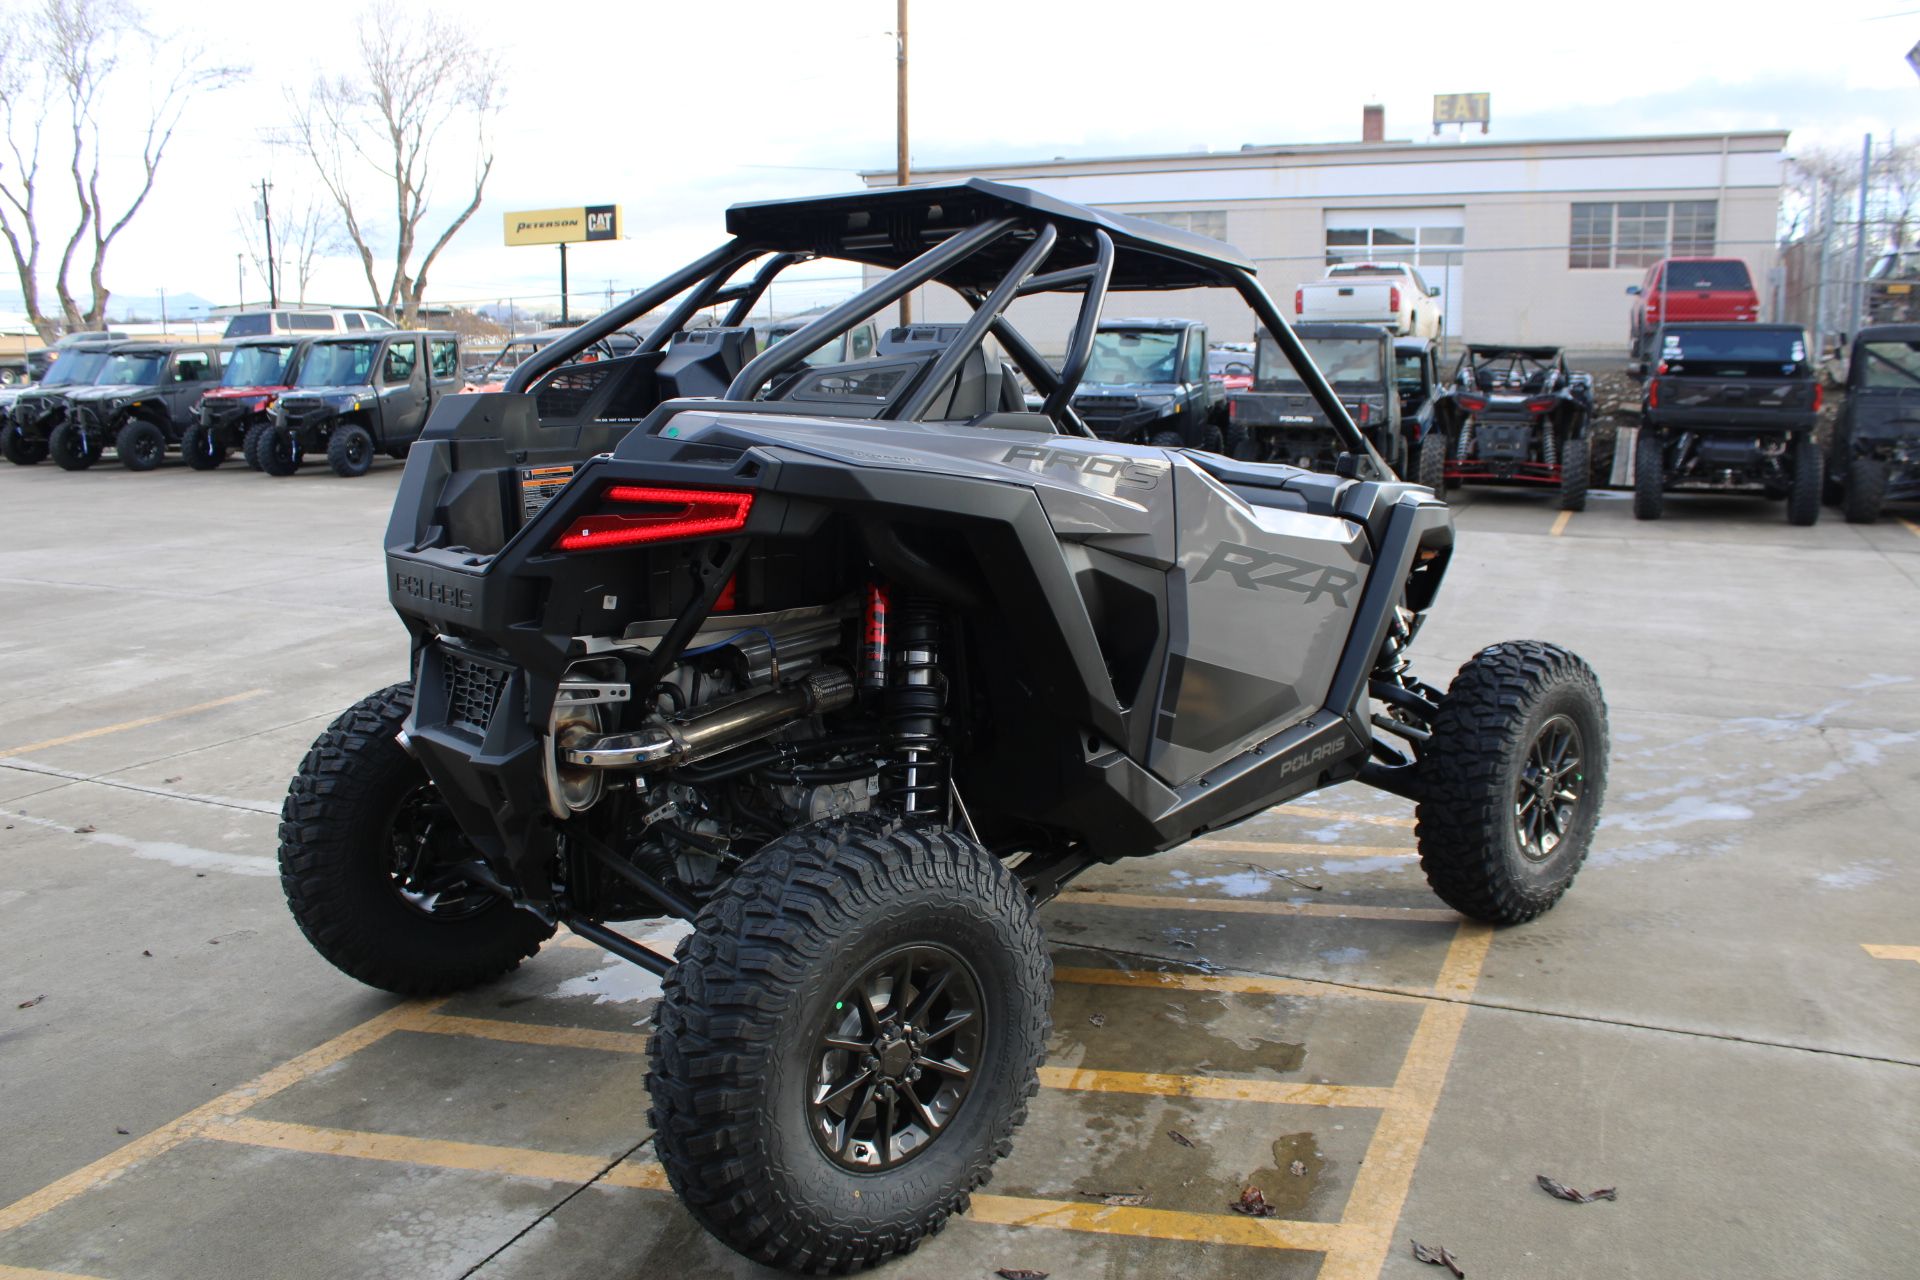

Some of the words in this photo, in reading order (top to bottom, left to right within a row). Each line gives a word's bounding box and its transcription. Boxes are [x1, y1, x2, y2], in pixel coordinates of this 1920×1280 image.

[1436, 95, 1488, 119] EAT
[516, 219, 578, 233] PETERSON
[587, 213, 612, 232] CAT
[395, 573, 474, 612] POLARIS
[1189, 541, 1358, 608] RZR
[1280, 735, 1346, 778] POLARIS
